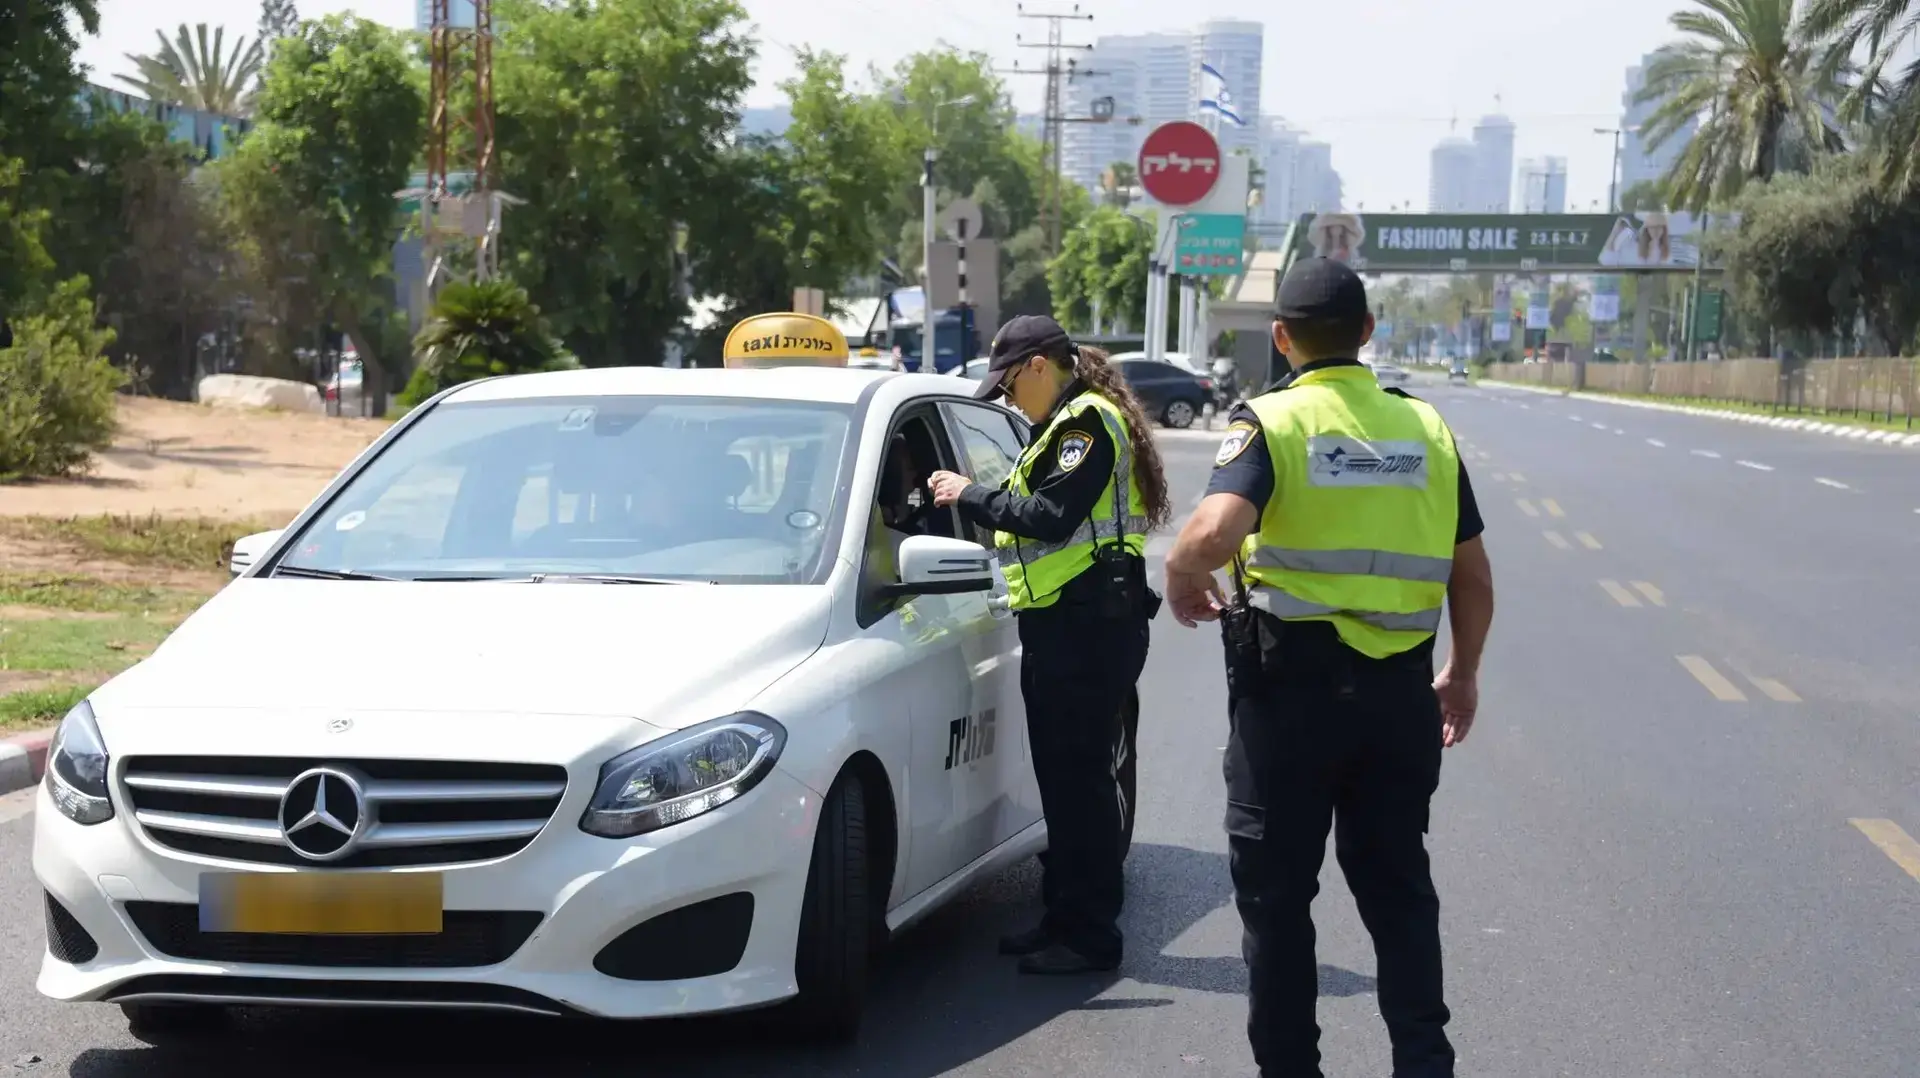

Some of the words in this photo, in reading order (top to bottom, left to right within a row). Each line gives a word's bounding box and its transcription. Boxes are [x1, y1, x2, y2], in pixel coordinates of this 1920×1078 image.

[1143, 152, 1216, 175] דלק
[1378, 227, 1463, 249] FASHION
[1467, 227, 1518, 250] SALE
[743, 334, 779, 353] taxi
[783, 336, 833, 351] מונית
